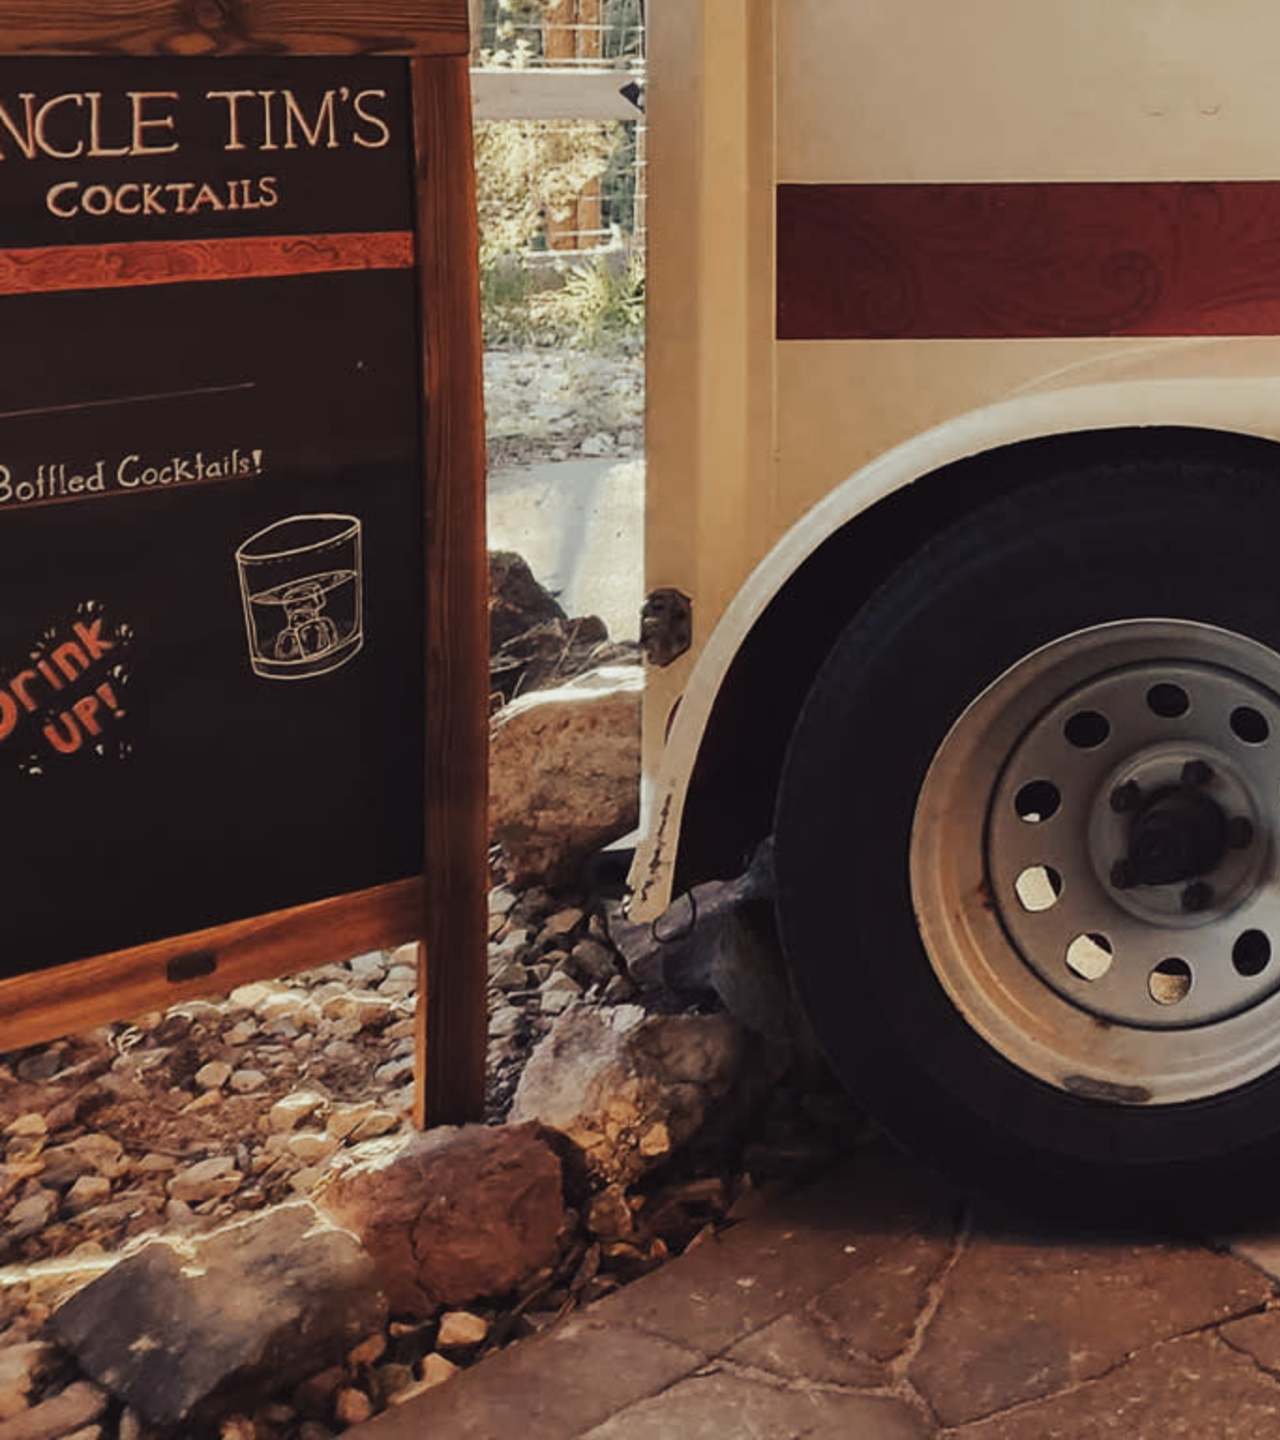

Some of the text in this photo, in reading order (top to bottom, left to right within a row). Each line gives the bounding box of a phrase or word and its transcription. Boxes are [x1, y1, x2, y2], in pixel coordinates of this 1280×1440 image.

[205, 86, 391, 151] TIM'S
[46, 176, 279, 218] COCKTAILS
[117, 449, 264, 488] Cocktails!
